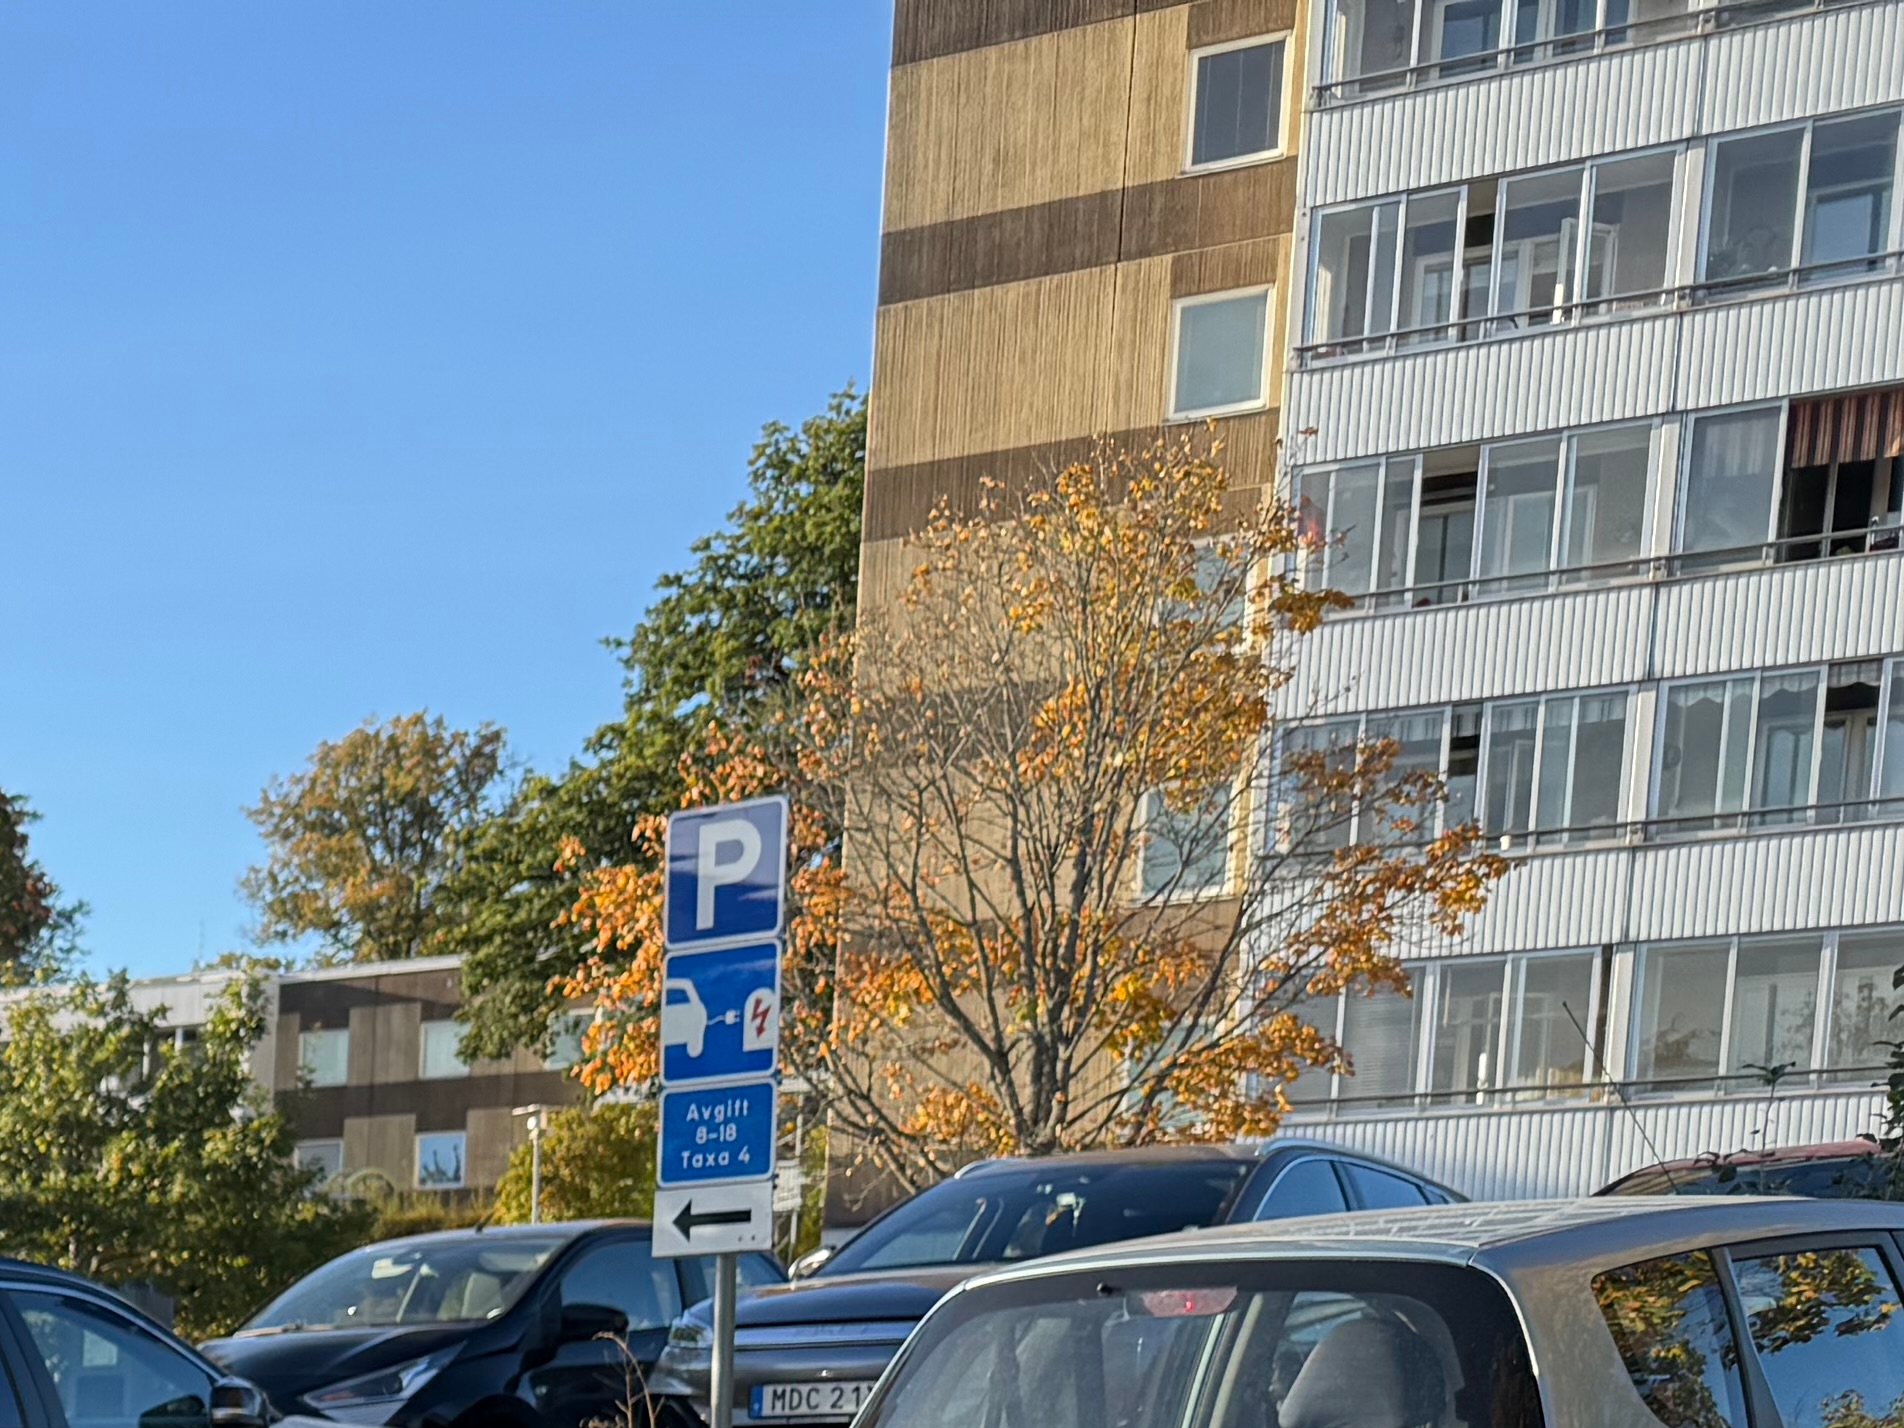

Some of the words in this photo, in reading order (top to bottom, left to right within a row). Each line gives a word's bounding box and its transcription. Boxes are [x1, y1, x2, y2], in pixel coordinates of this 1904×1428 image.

[696, 819, 762, 930] P
[686, 1098, 749, 1123] Avgift
[695, 1123, 737, 1144] 8-18
[681, 1150, 729, 1169] Taxa
[738, 1145, 750, 1164] 4
[772, 1387, 820, 1411] MDC
[830, 1385, 873, 1409] 21
